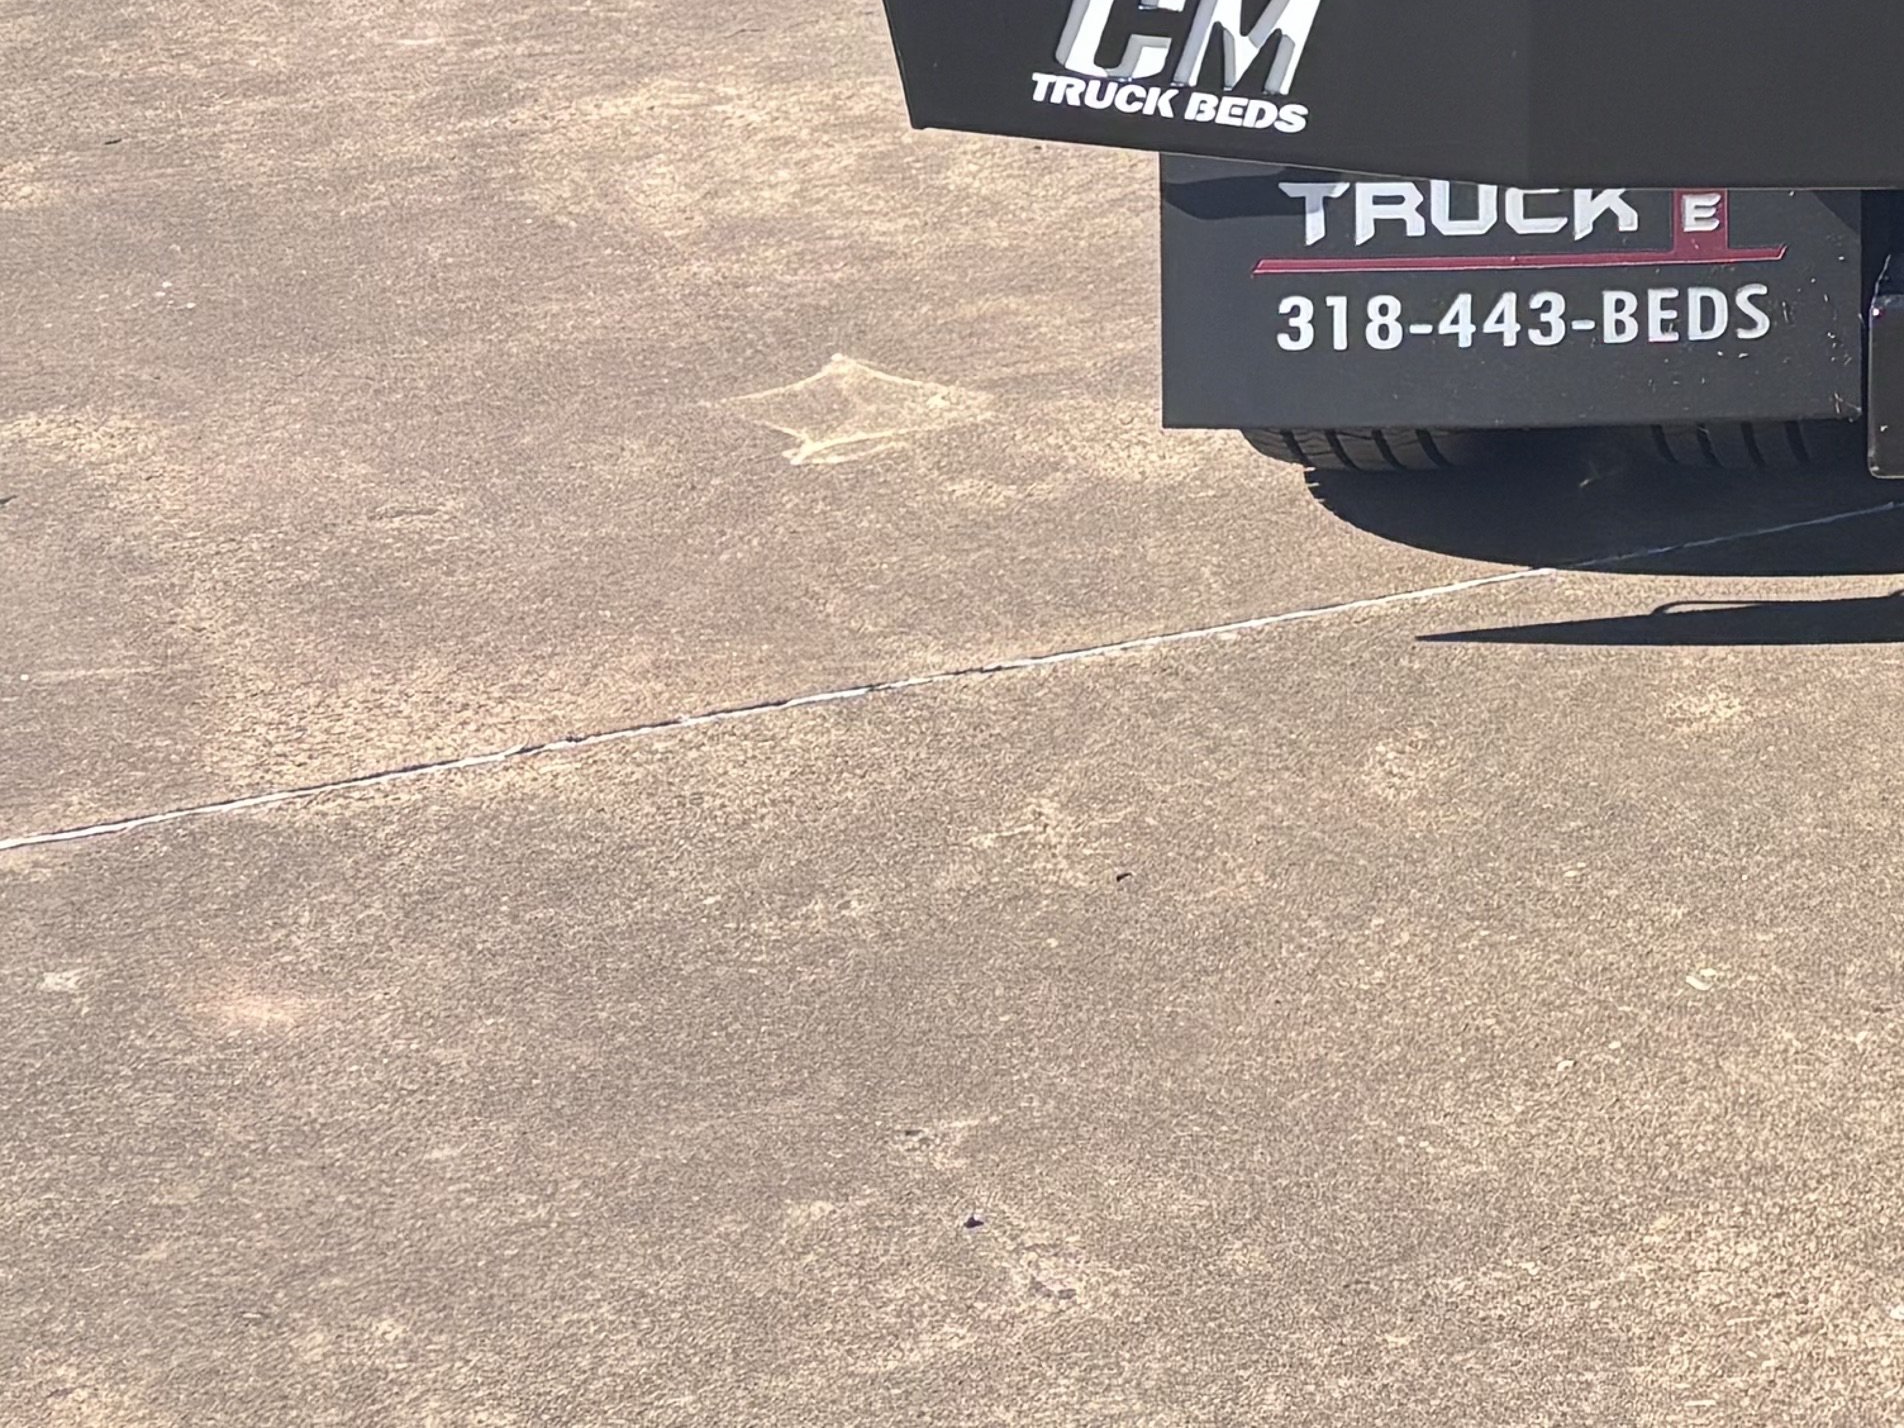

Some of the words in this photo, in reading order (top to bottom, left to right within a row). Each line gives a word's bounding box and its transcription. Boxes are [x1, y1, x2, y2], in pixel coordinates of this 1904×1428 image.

[1031, 72, 1179, 118] TRUCK
[1184, 92, 1310, 133] BEDS
[1278, 180, 1639, 246] TRUCK
[1276, 284, 1771, 352] 318-443-BEDS
